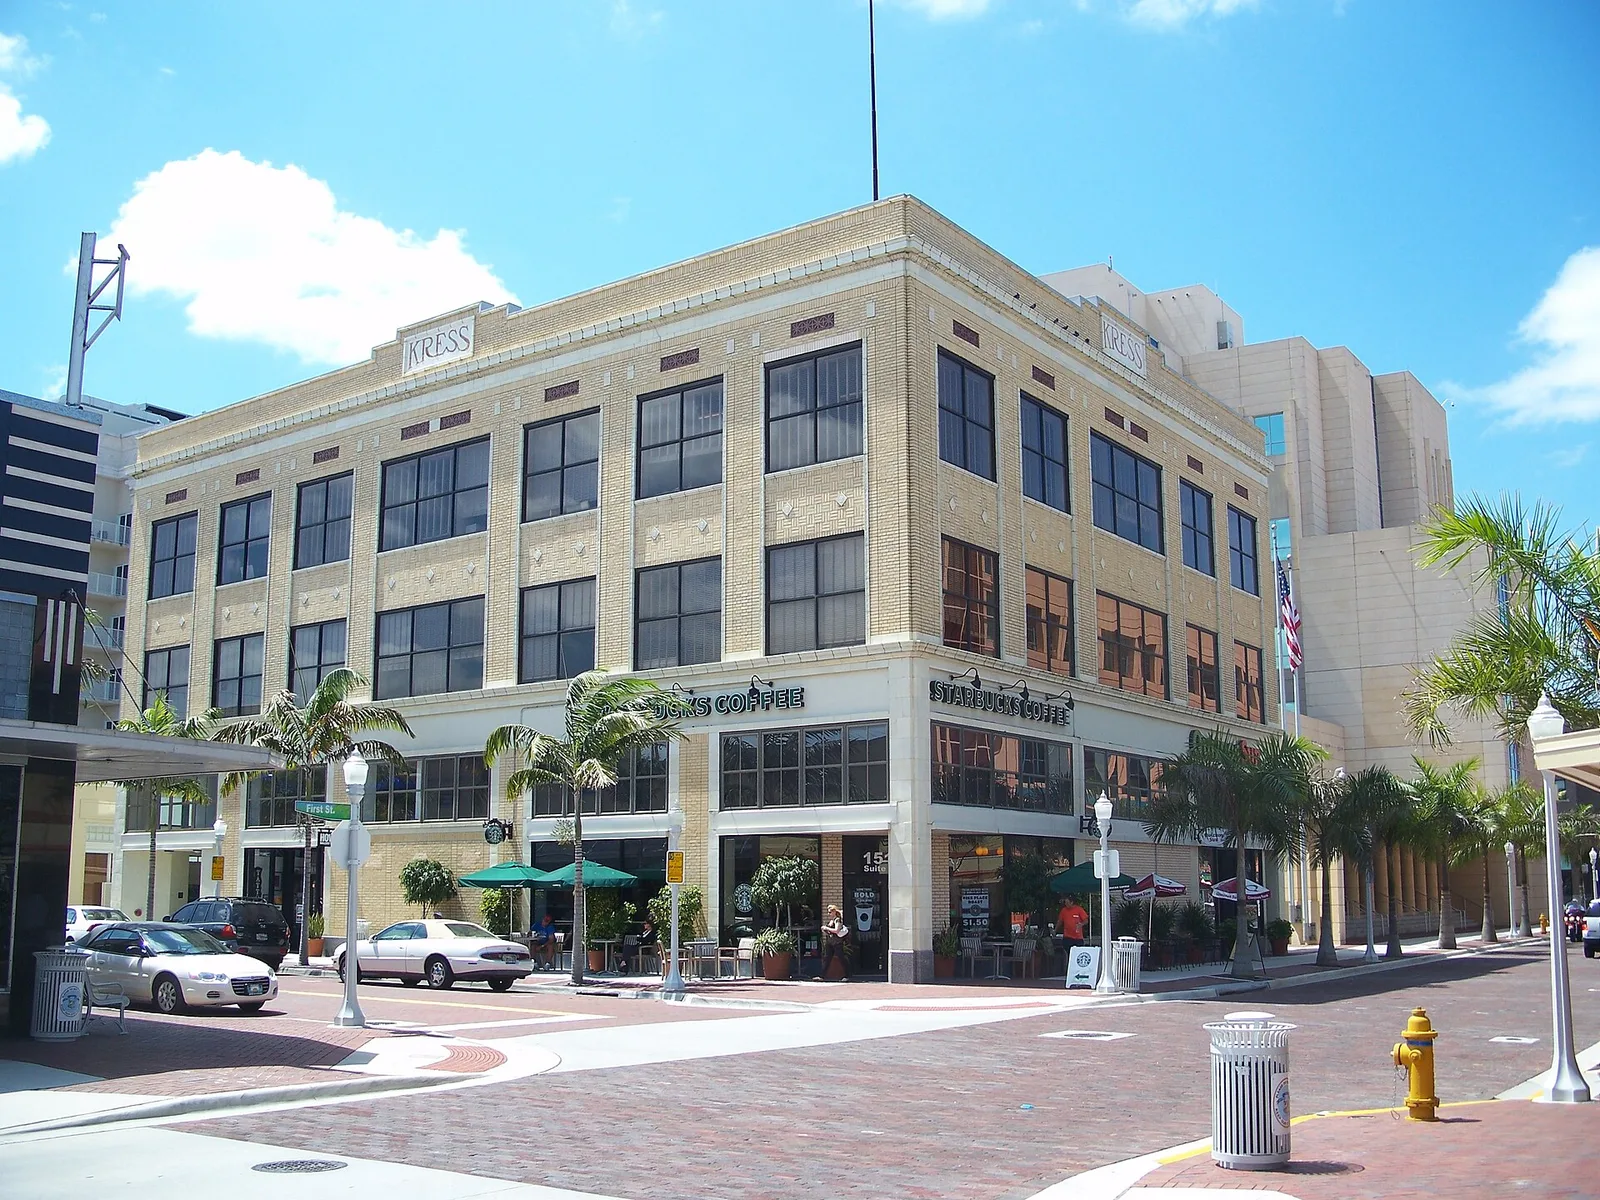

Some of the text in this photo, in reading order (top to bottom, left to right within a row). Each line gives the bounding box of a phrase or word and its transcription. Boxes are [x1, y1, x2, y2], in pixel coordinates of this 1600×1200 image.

[408, 325, 470, 370] KRESS
[1103, 320, 1143, 370] KRESS
[714, 687, 804, 715] COFFEE
[930, 680, 1070, 726] STARBUCKS COFFEE
[306, 804, 336, 814] First St.
[962, 918, 988, 926] $1.50
